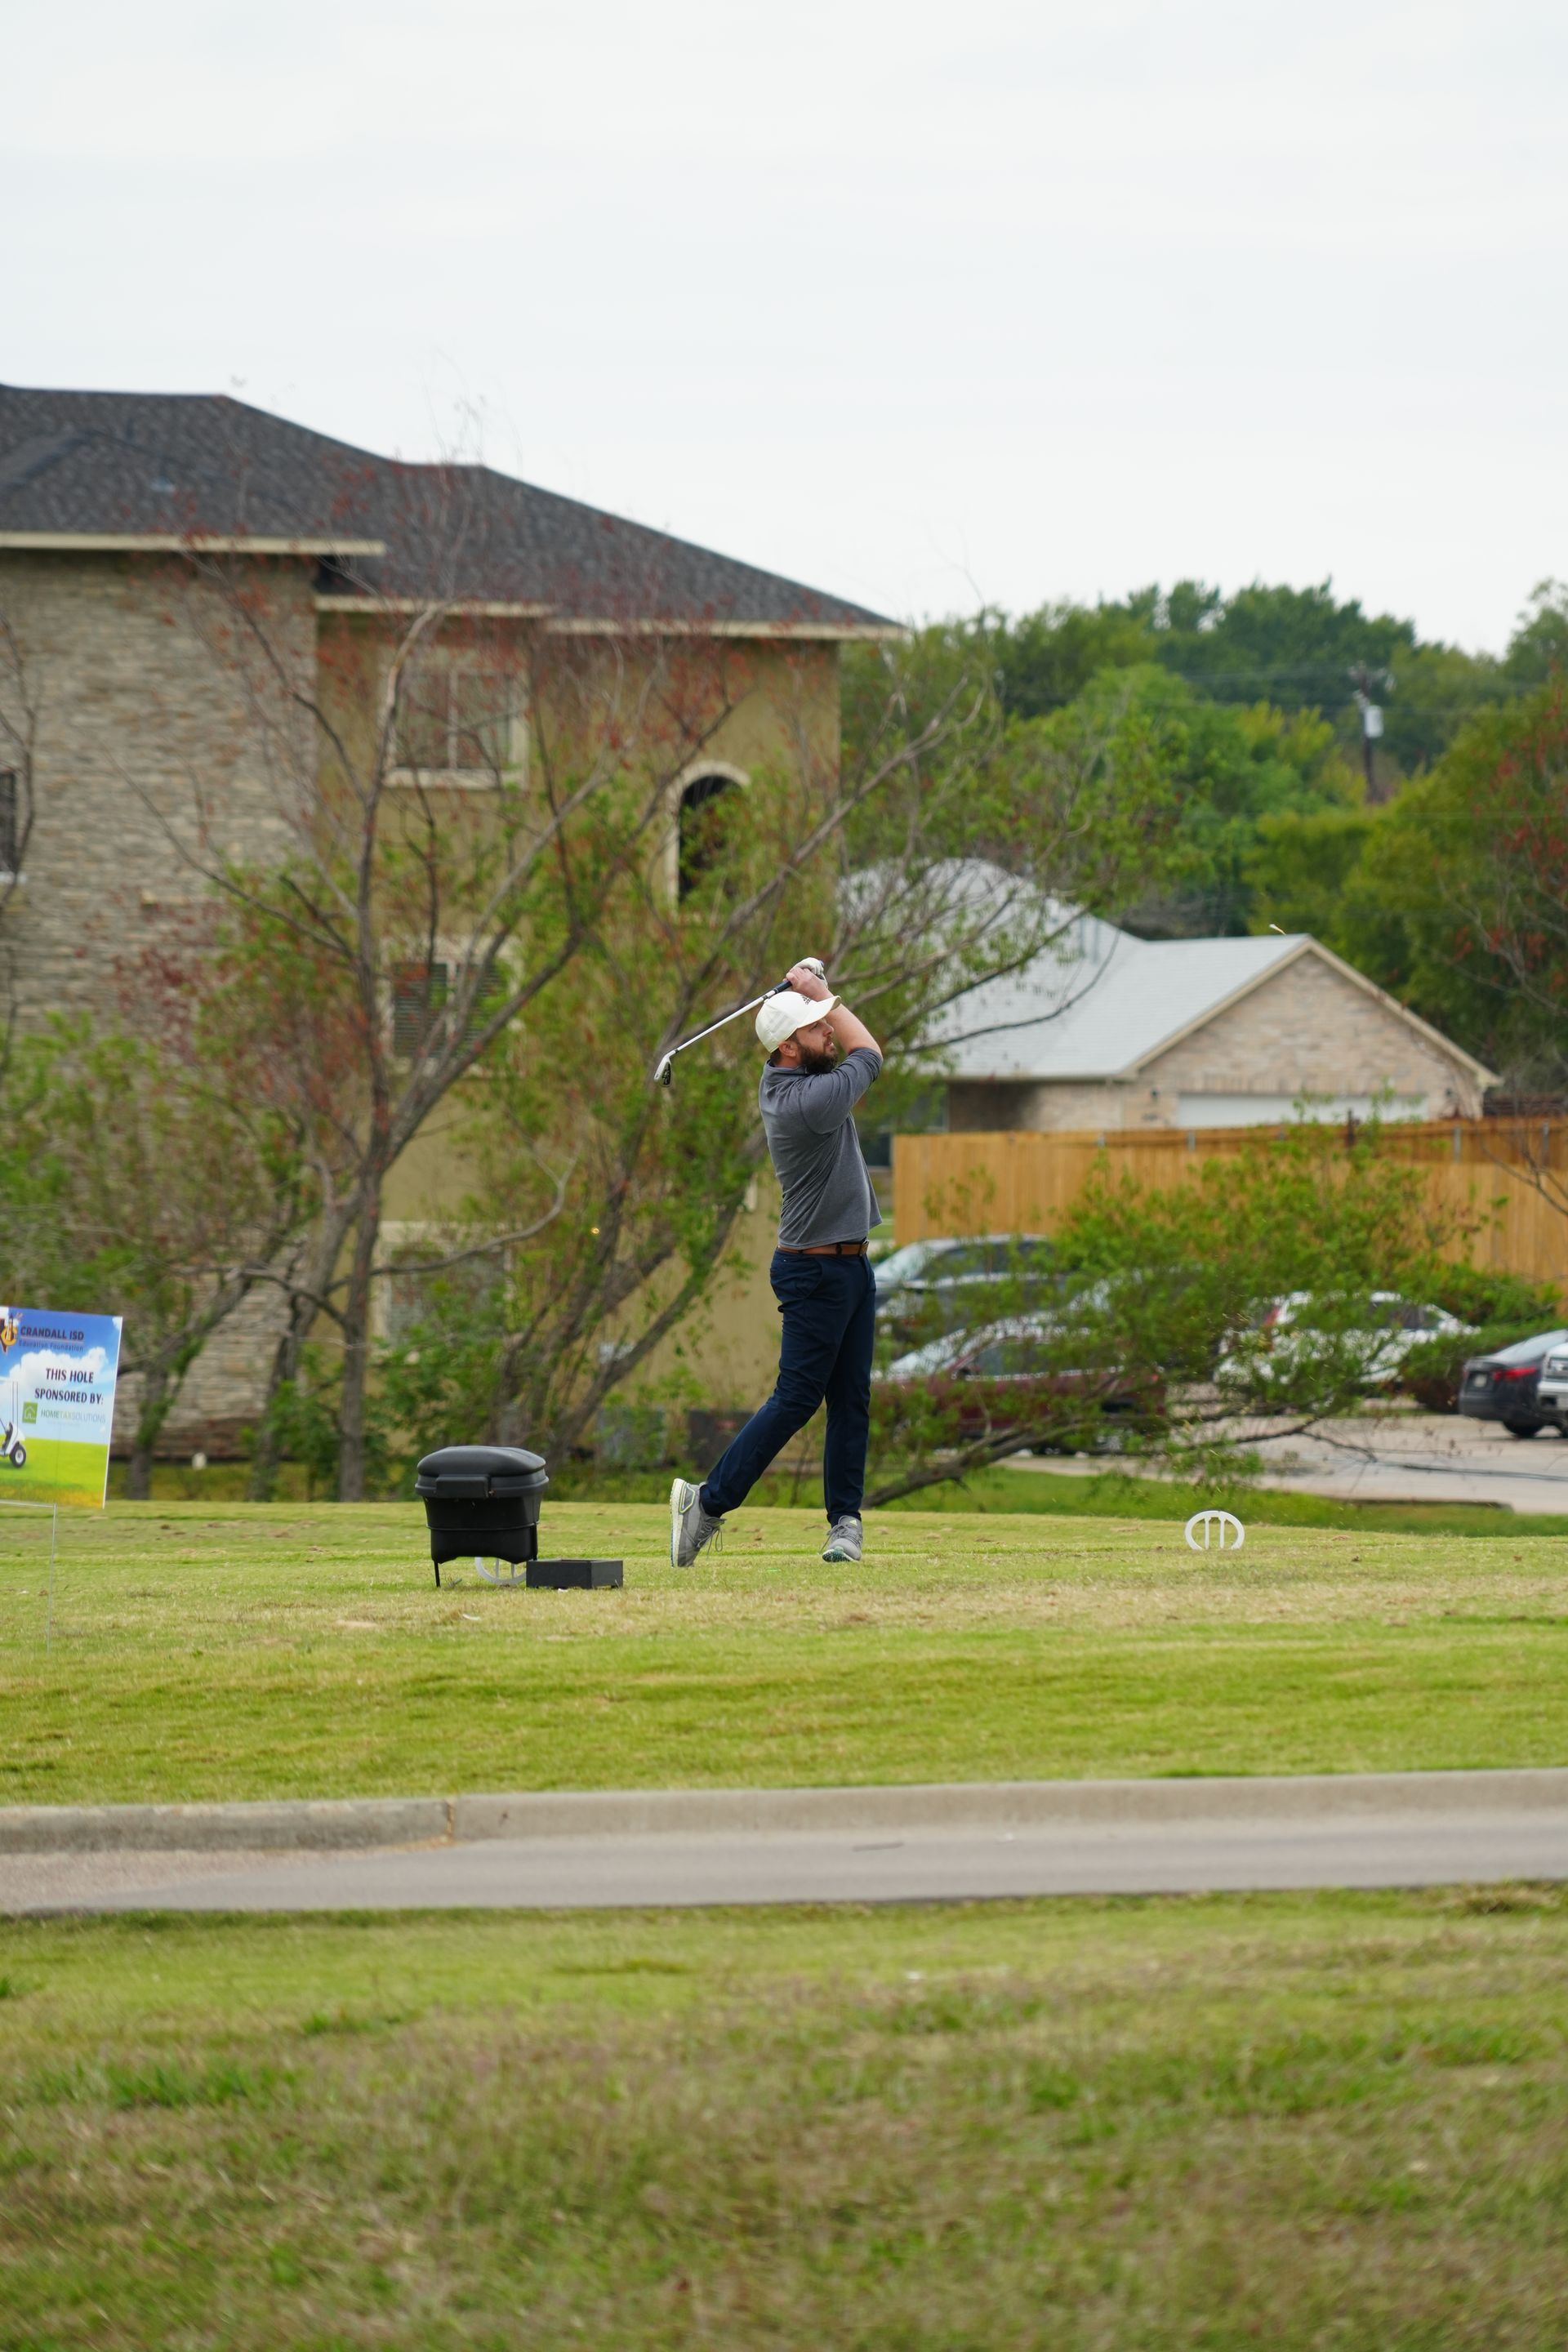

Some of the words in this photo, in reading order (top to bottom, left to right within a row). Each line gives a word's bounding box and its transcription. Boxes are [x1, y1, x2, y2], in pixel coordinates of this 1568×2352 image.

[20, 1325, 67, 1339] CRANDALL
[69, 1330, 84, 1340] ISD
[46, 1367, 67, 1381] THIS
[69, 1370, 94, 1383] HOLE
[34, 1388, 87, 1403] SPONSORED
[90, 1392, 104, 1405] BY:
